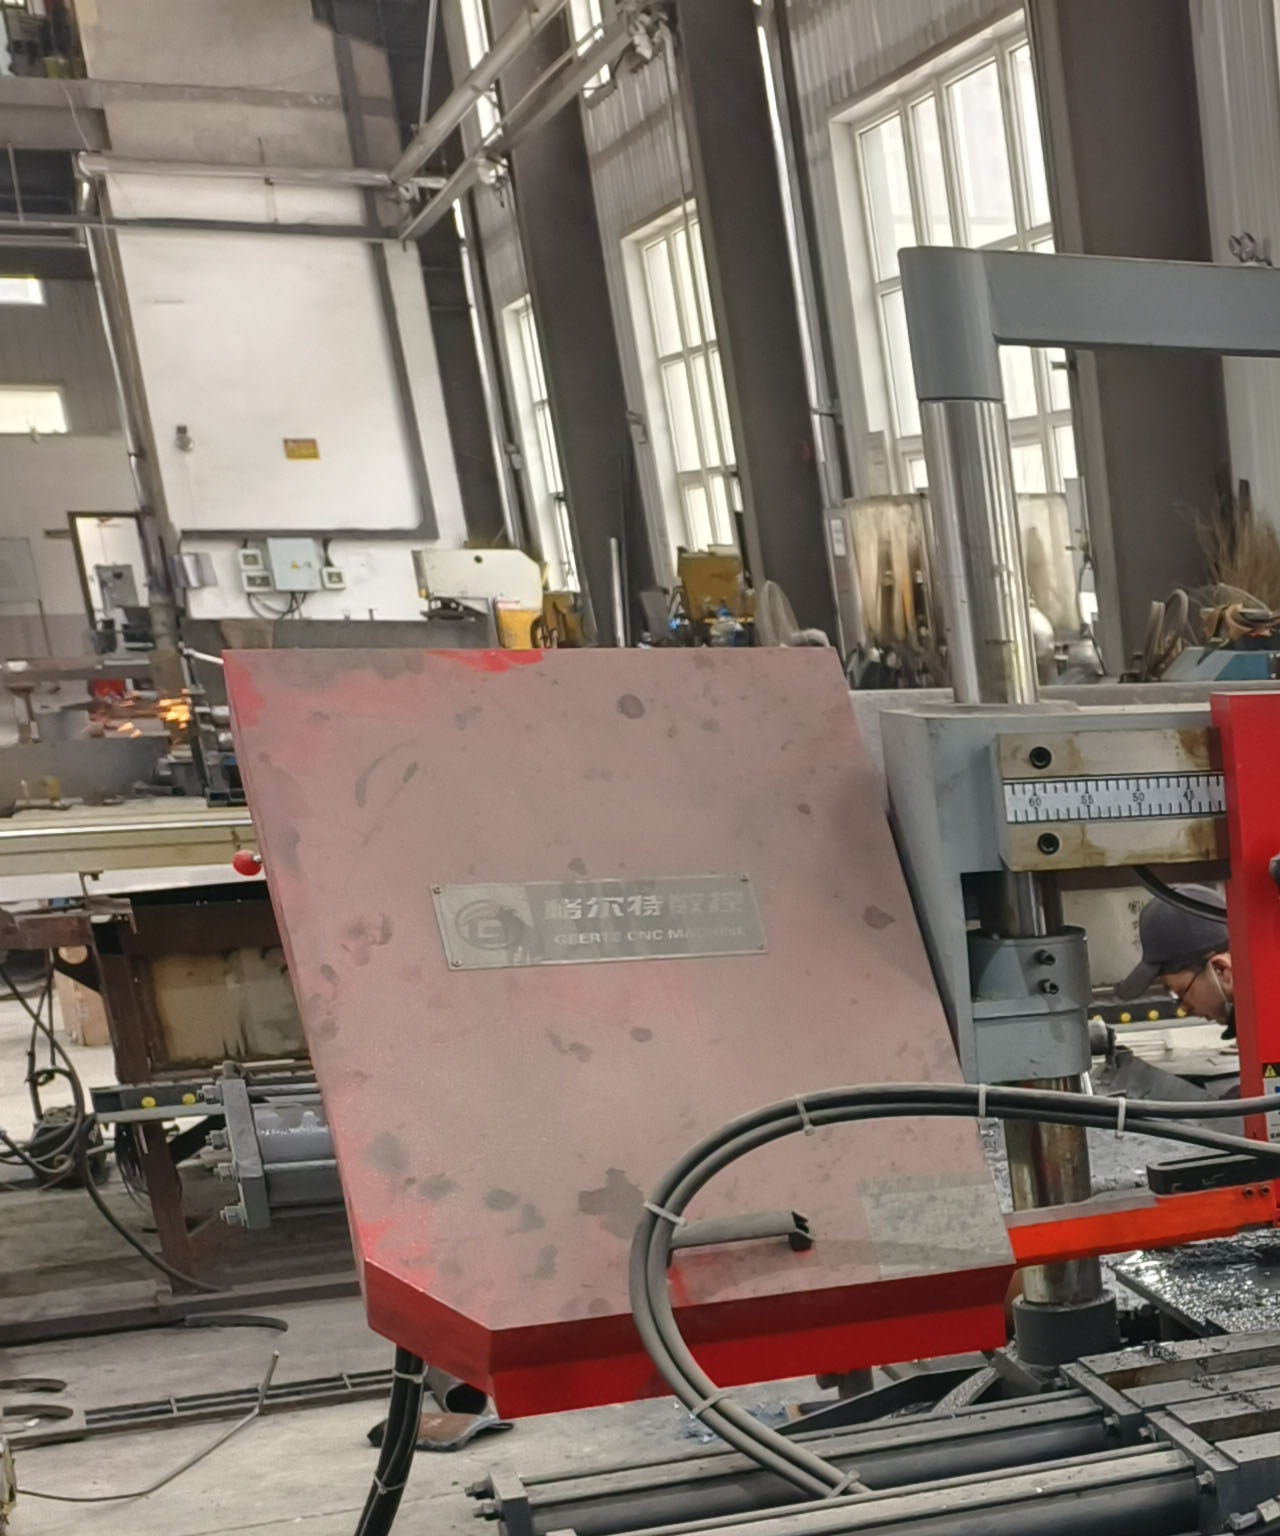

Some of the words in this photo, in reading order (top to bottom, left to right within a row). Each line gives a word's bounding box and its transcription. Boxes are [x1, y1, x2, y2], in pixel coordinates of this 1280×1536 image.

[1029, 797, 1042, 807] 60
[1132, 792, 1145, 803] 50
[627, 928, 663, 942] CNC
